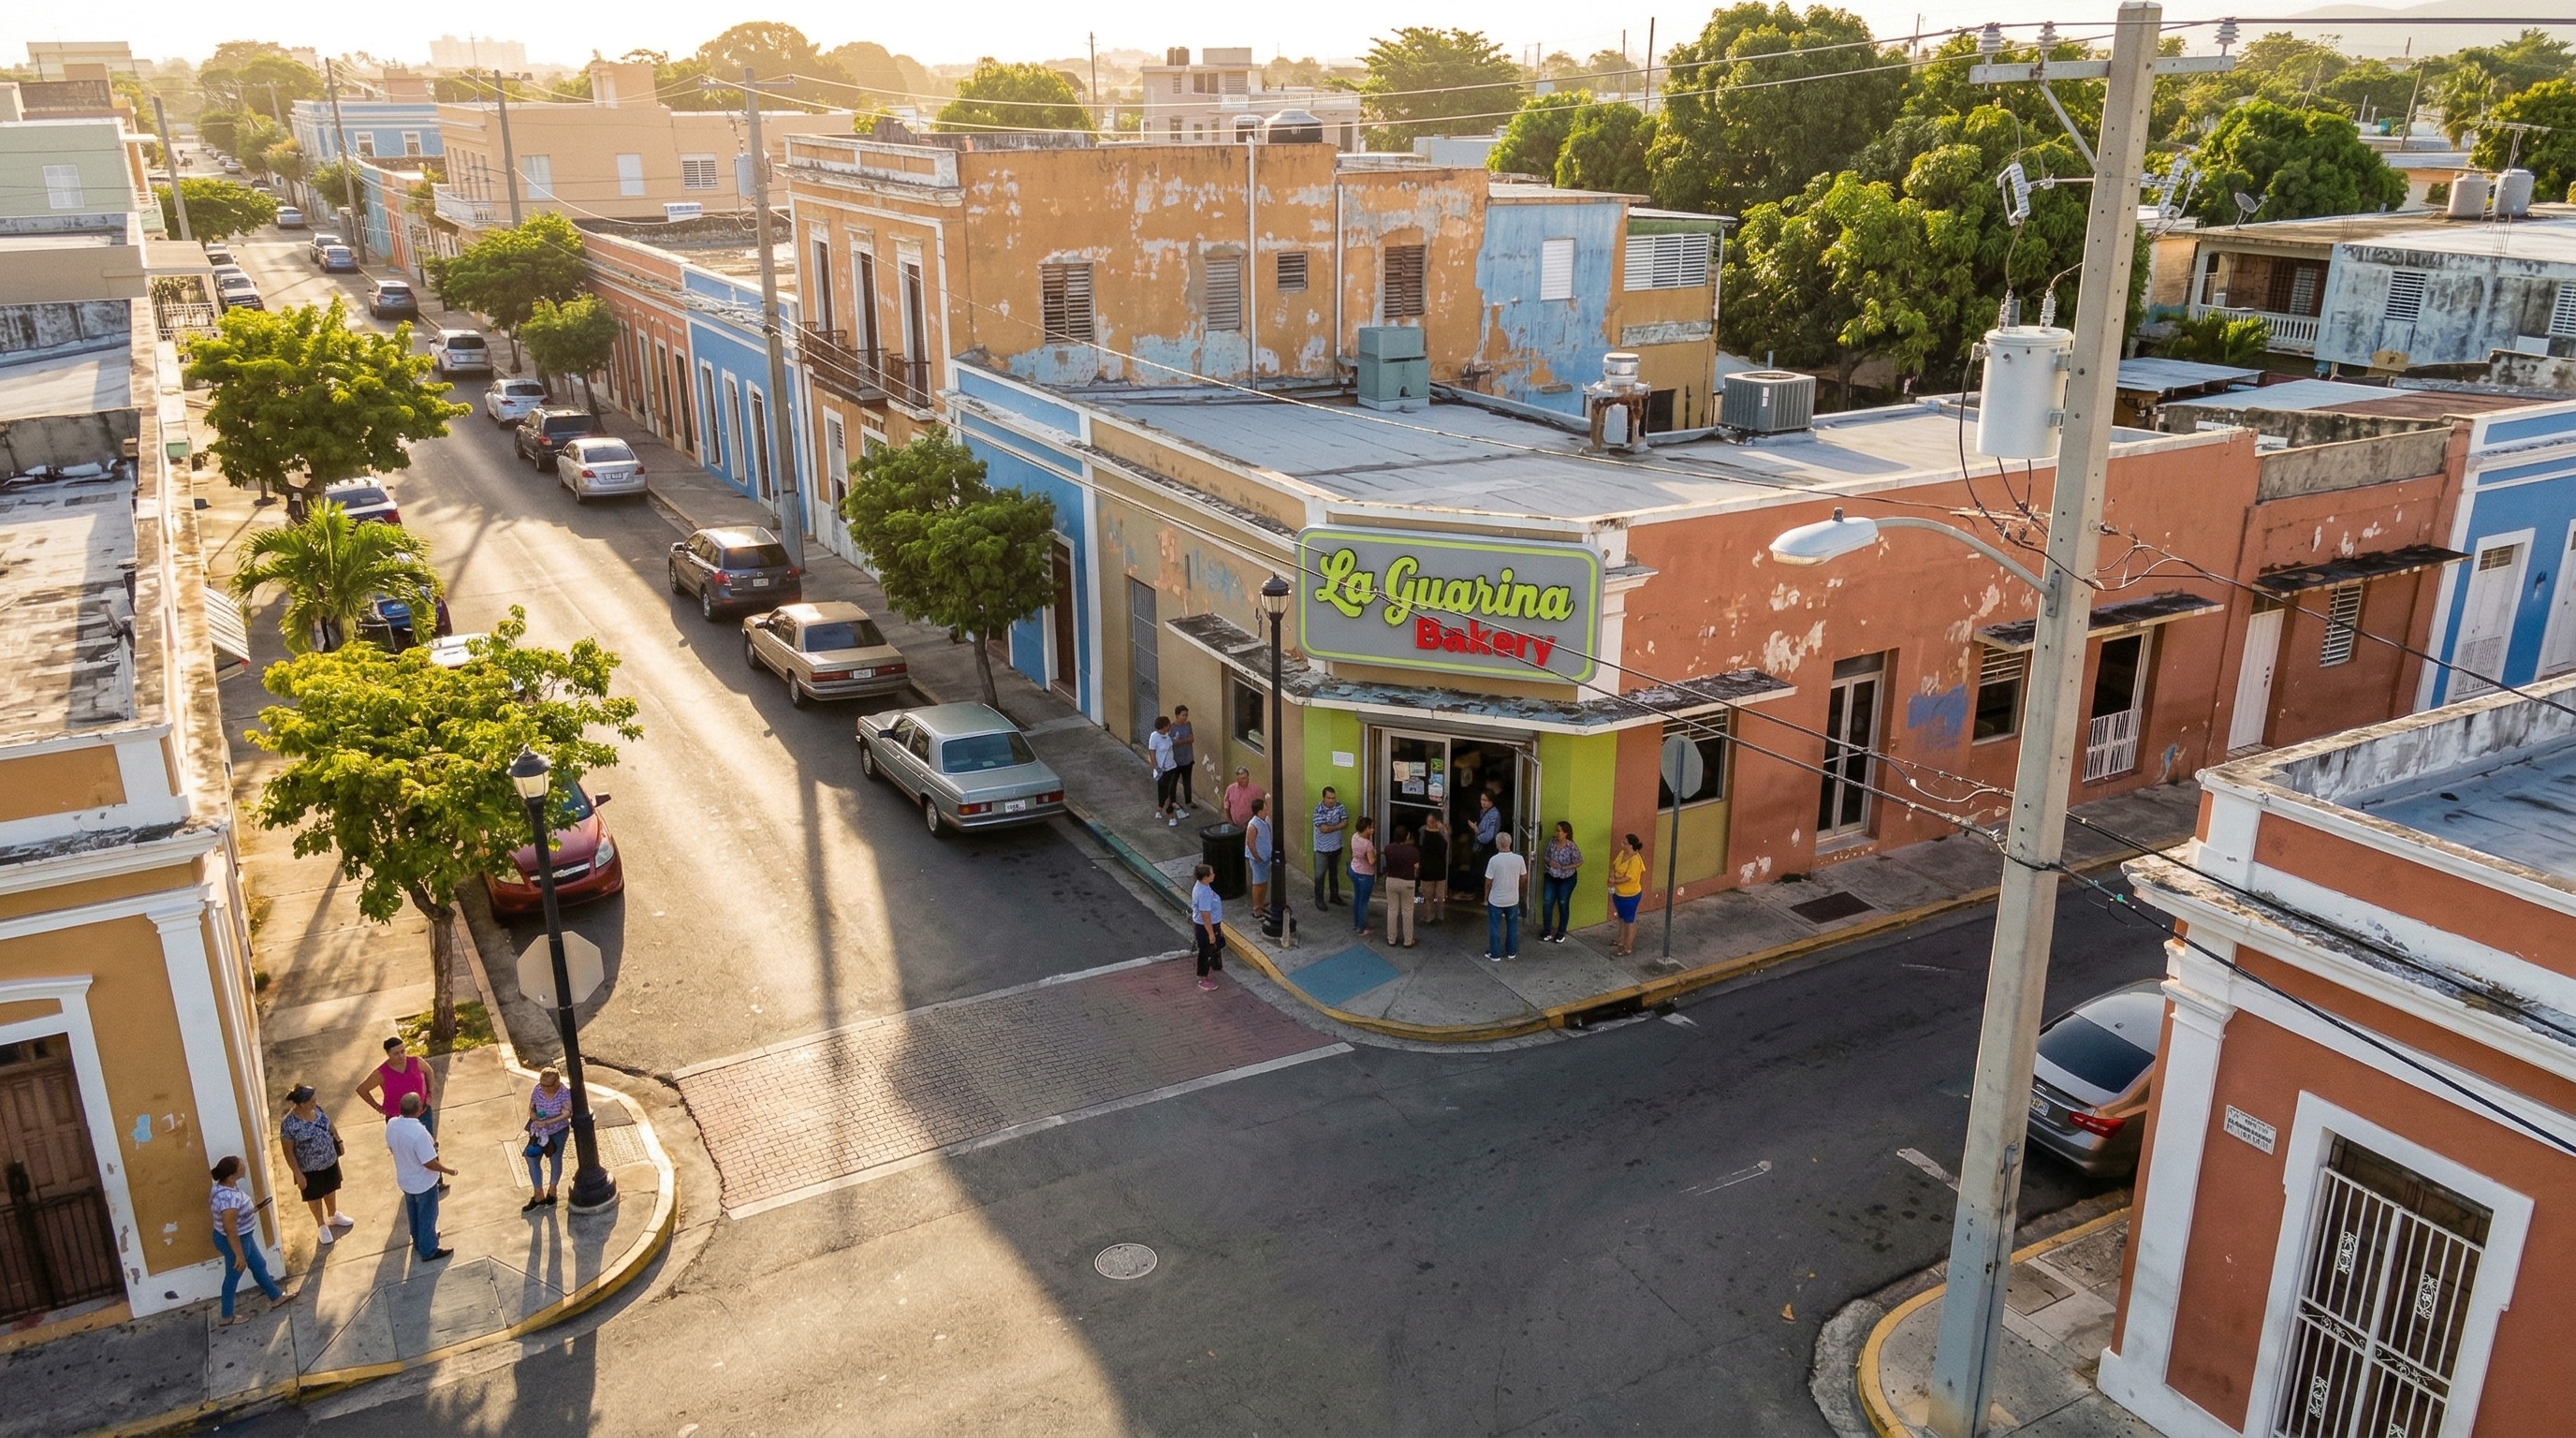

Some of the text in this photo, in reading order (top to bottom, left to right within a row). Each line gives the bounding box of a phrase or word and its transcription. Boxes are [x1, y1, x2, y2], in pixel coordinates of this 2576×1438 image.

[1314, 548, 1574, 626] La Guarina
[1414, 616, 1556, 667] Bakery
